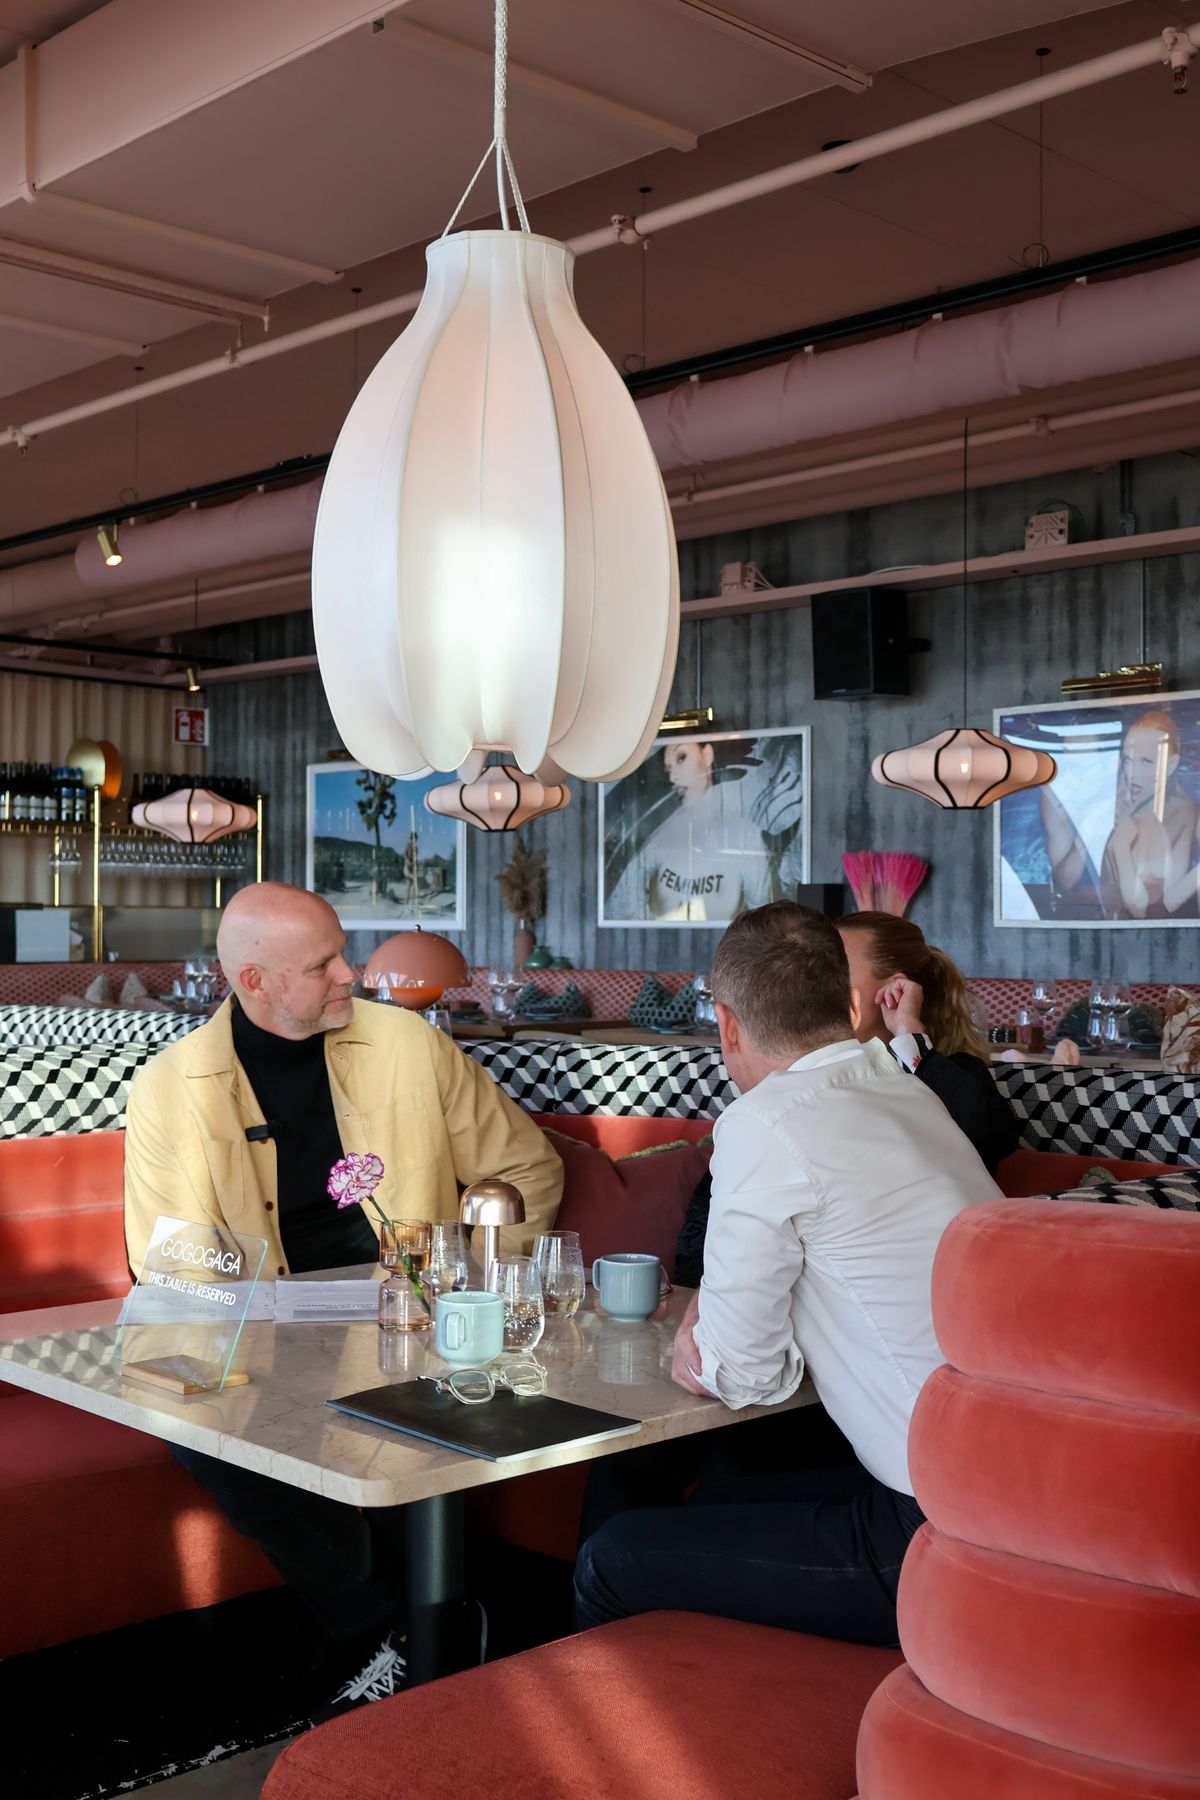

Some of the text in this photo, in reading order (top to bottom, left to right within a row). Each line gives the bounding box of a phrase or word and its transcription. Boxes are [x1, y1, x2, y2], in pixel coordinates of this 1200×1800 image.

[161, 1238, 241, 1275] GOGOGAGA
[147, 1271, 237, 1306] THIS TABLE IS RESERVED
